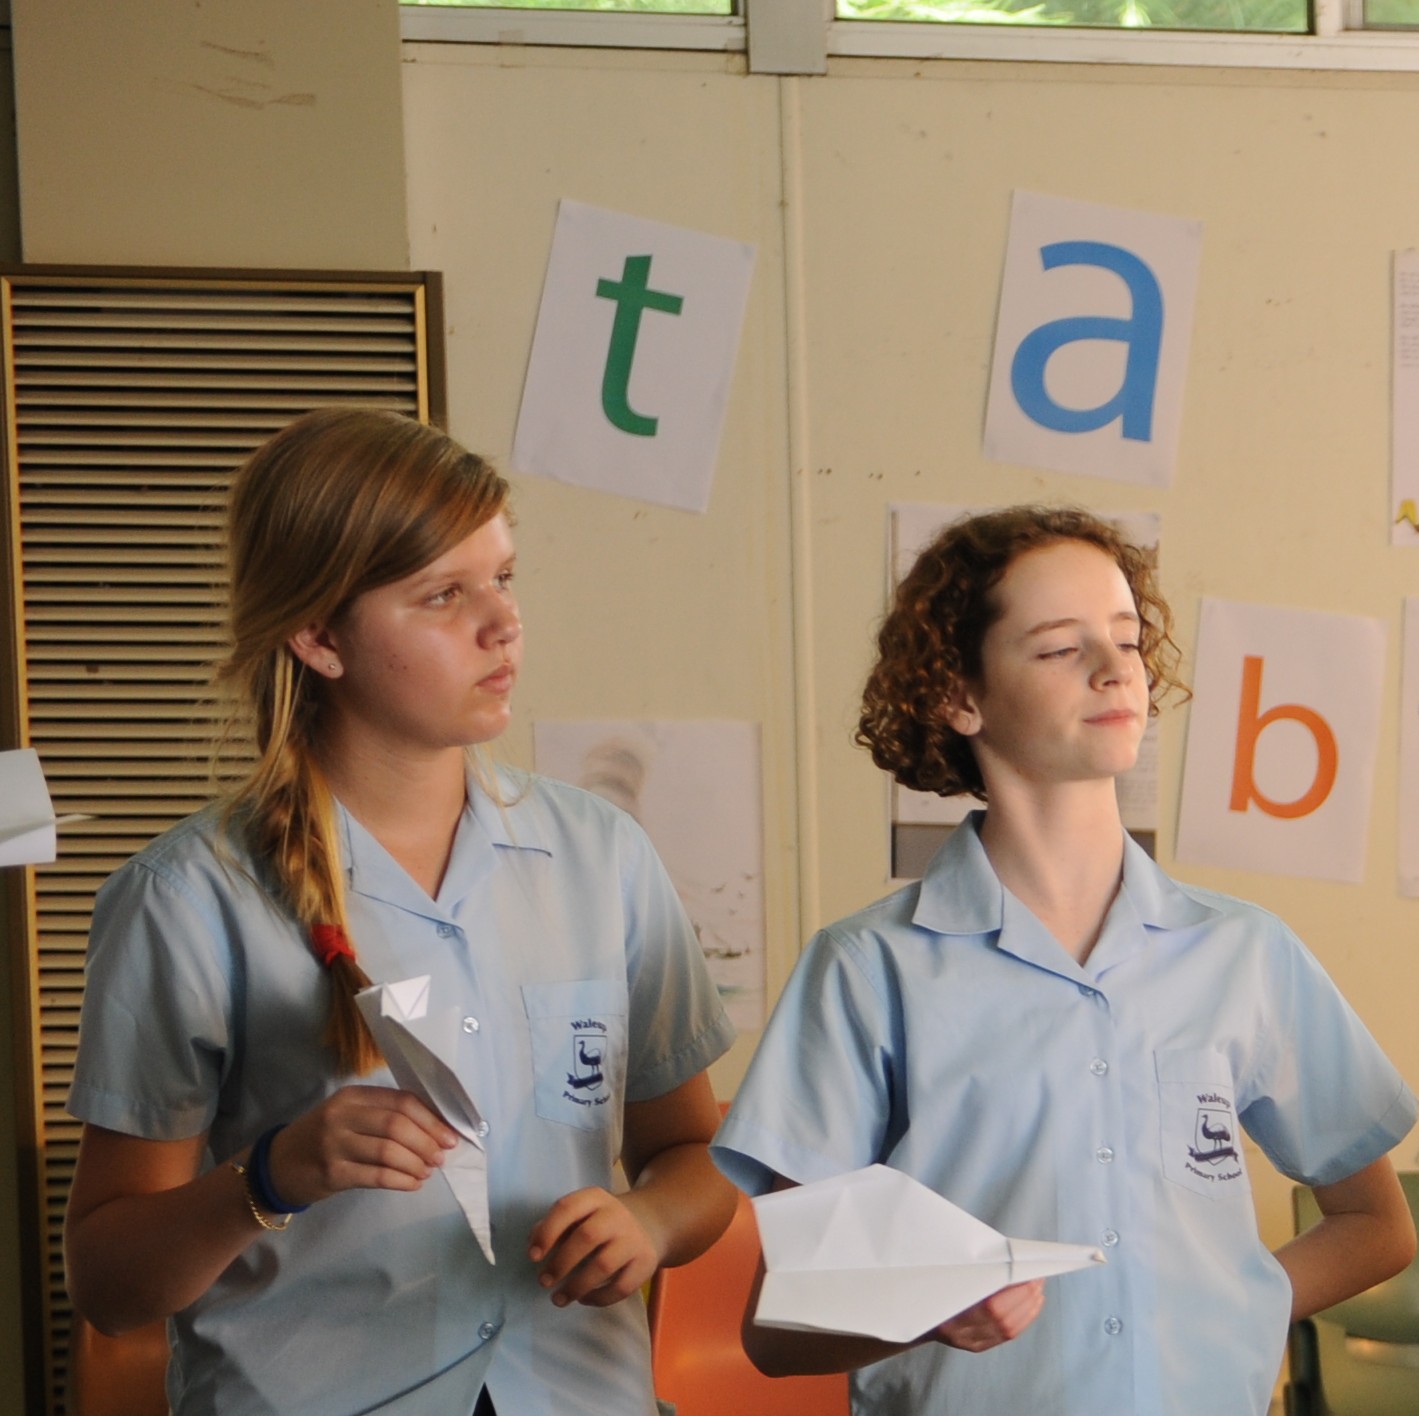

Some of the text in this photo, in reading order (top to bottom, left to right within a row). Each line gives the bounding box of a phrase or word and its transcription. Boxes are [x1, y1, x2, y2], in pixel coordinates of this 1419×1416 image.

[595, 254, 684, 438] t
[1010, 240, 1165, 443] a
[1228, 655, 1339, 820] b
[1218, 1168, 1242, 1181] School
